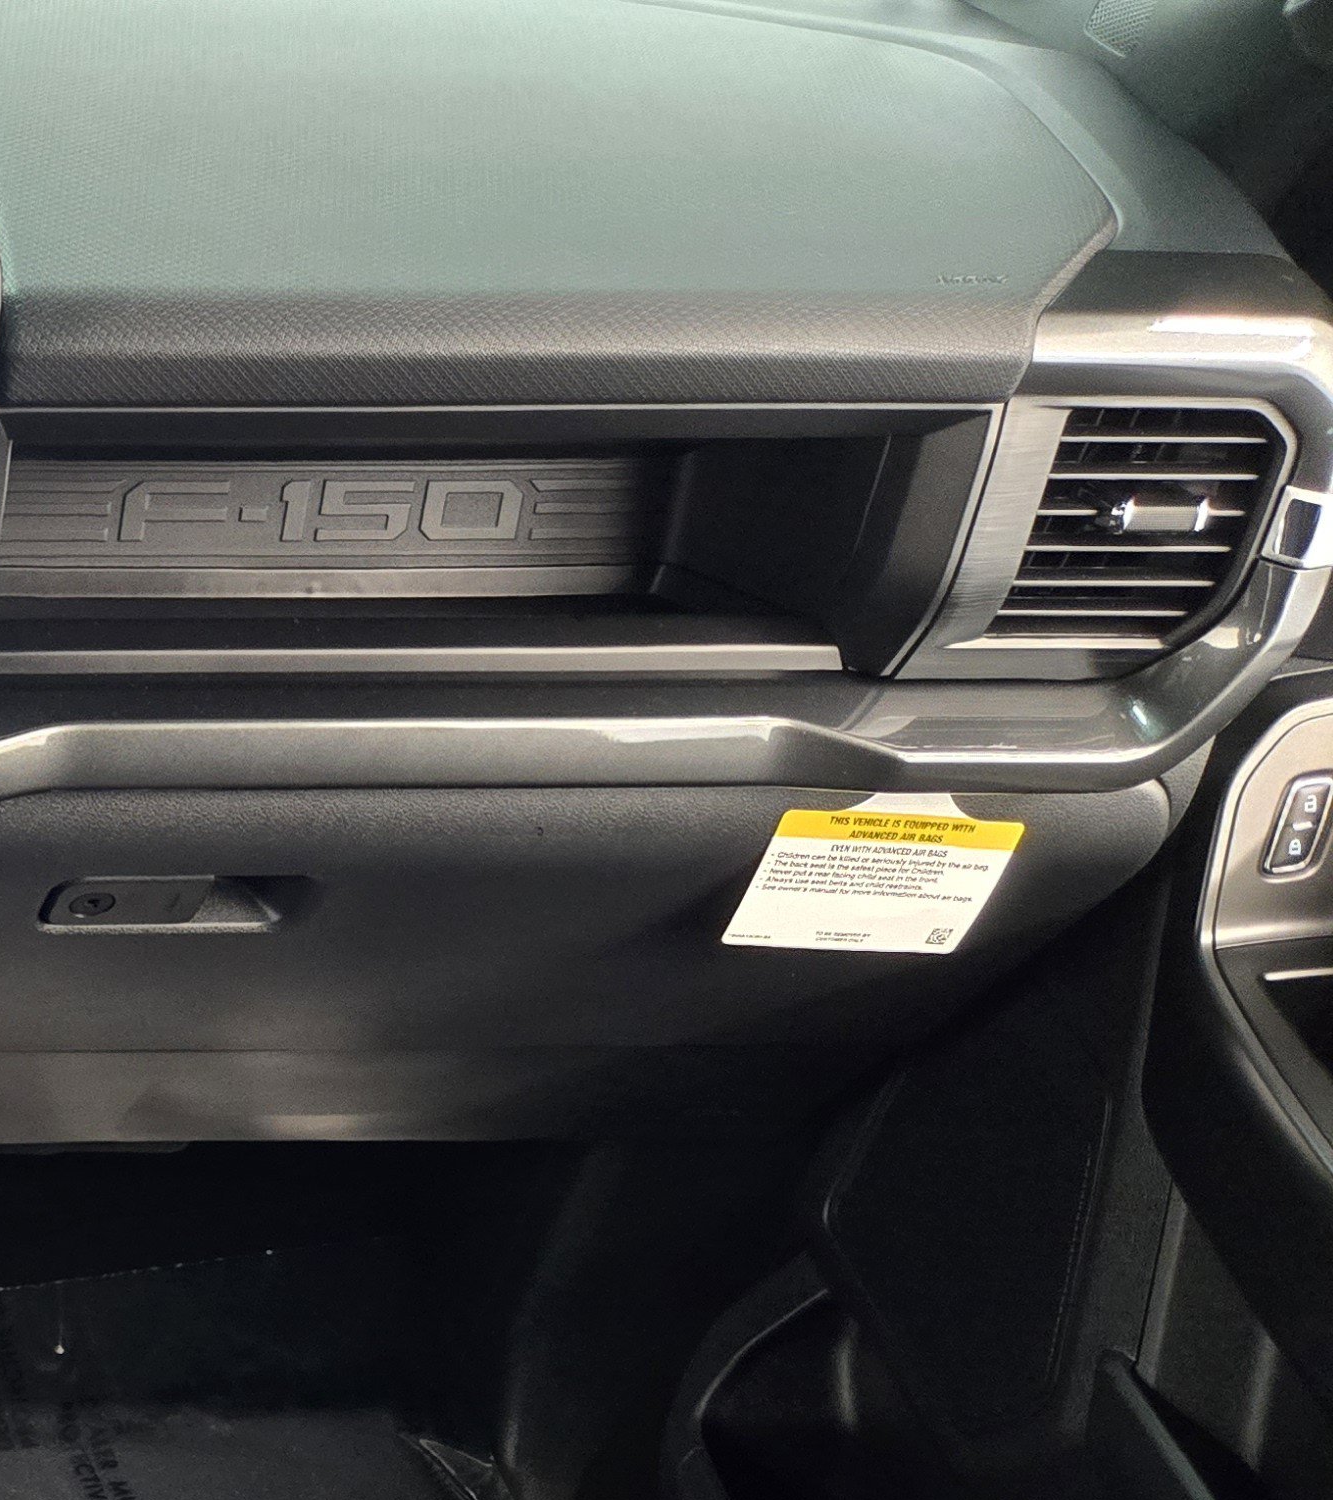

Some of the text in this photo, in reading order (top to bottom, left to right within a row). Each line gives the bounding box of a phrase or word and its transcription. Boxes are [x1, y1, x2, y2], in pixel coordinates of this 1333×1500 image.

[117, 478, 524, 543] F-150
[830, 816, 976, 833] THIS VEHICLE IS EQUIPPED WITH
[849, 830, 943, 844] ADVANCED AIR BAGS
[830, 844, 948, 858] EVEN WITH ADVANCED AIR BAGS
